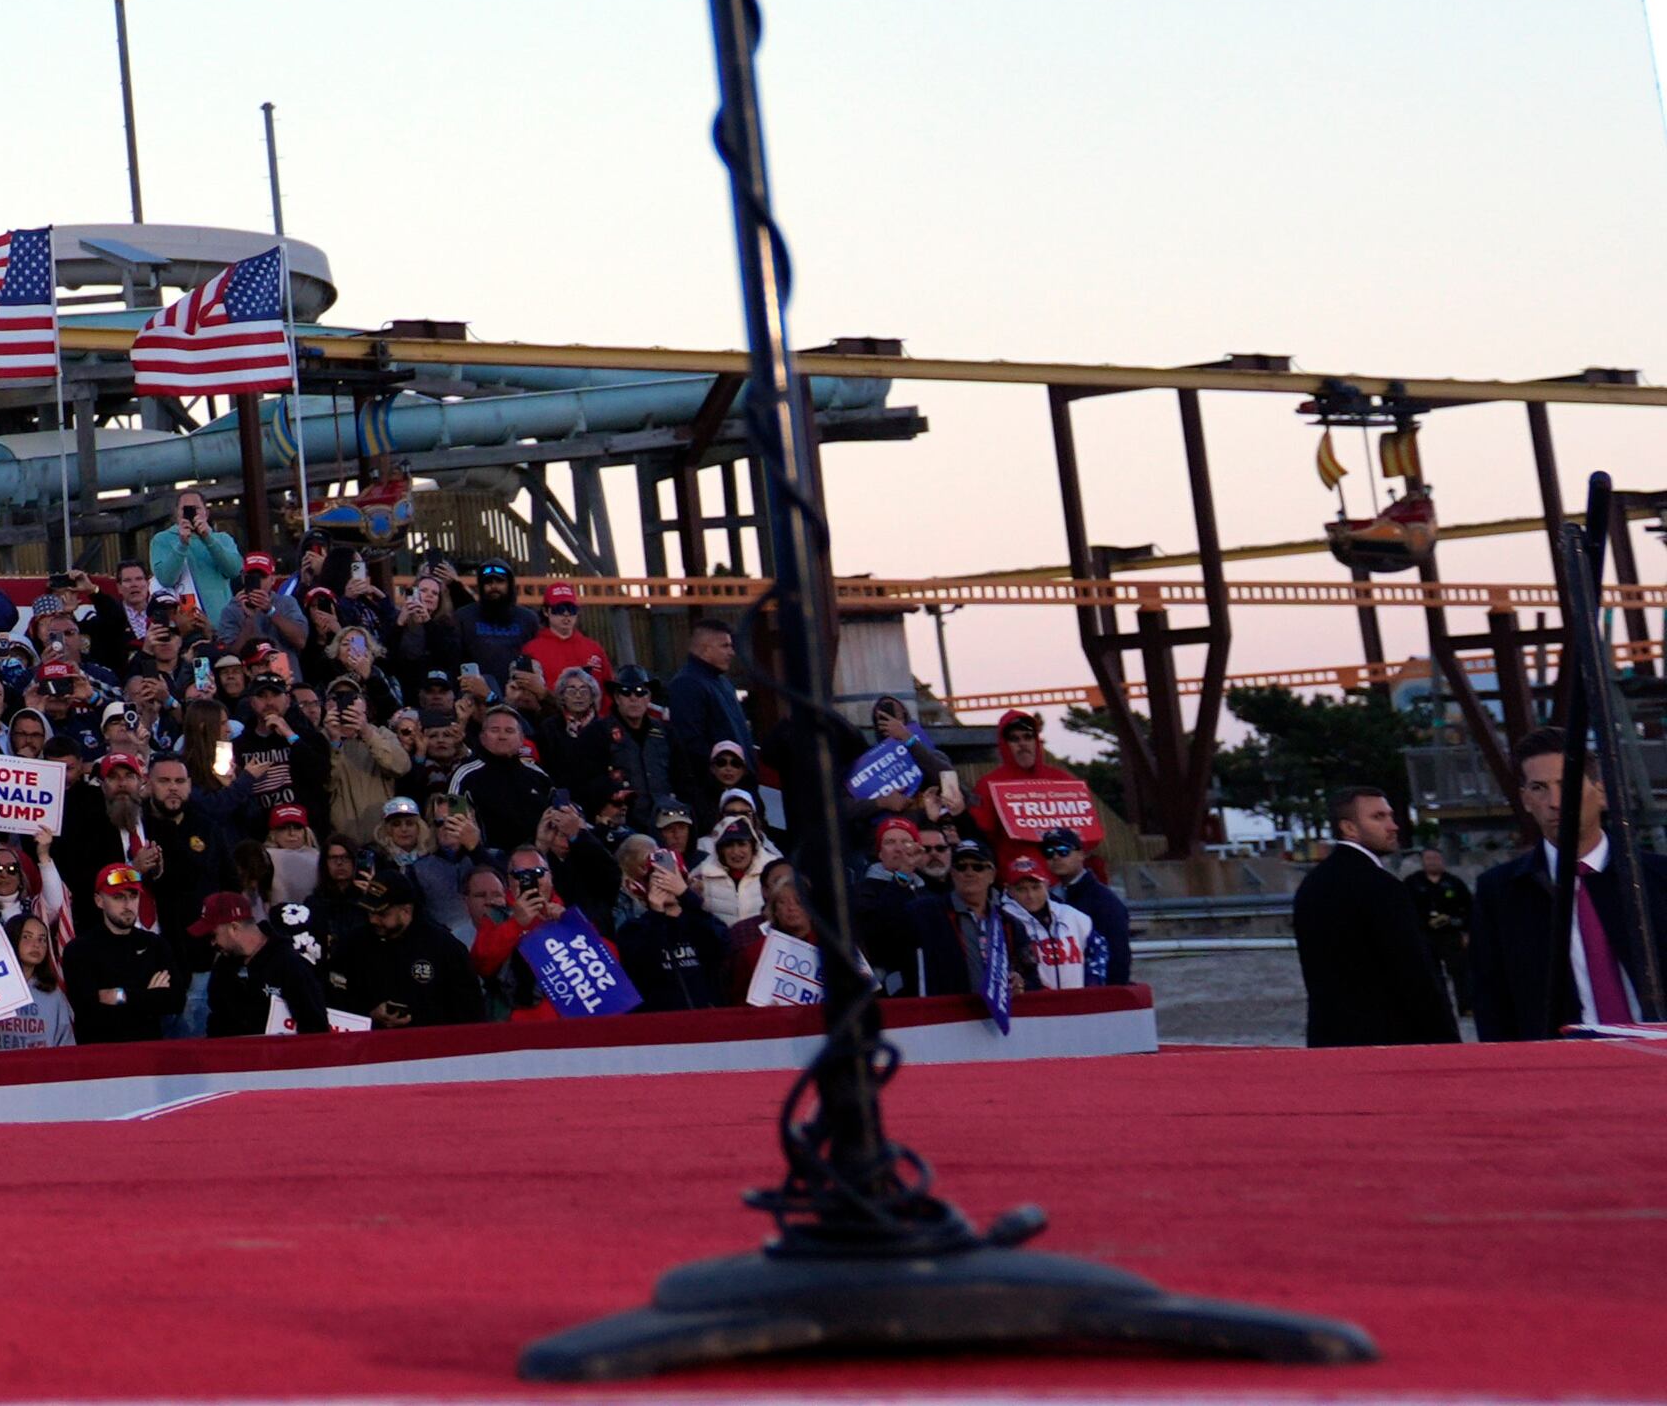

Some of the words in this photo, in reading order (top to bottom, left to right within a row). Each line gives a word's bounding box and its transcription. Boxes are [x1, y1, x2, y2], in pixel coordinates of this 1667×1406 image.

[851, 752, 897, 788] BETTER
[868, 764, 922, 800] RUM
[260, 788, 295, 808] 020
[1008, 801, 1092, 816] TRUMP
[1016, 816, 1094, 828] COUNTRY
[545, 938, 602, 1014] TRUMP
[569, 934, 616, 991] 2024
[776, 949, 812, 975] TOO
[541, 961, 574, 1006] VOTE
[774, 976, 796, 997] TO
[799, 988, 824, 1005] RI
